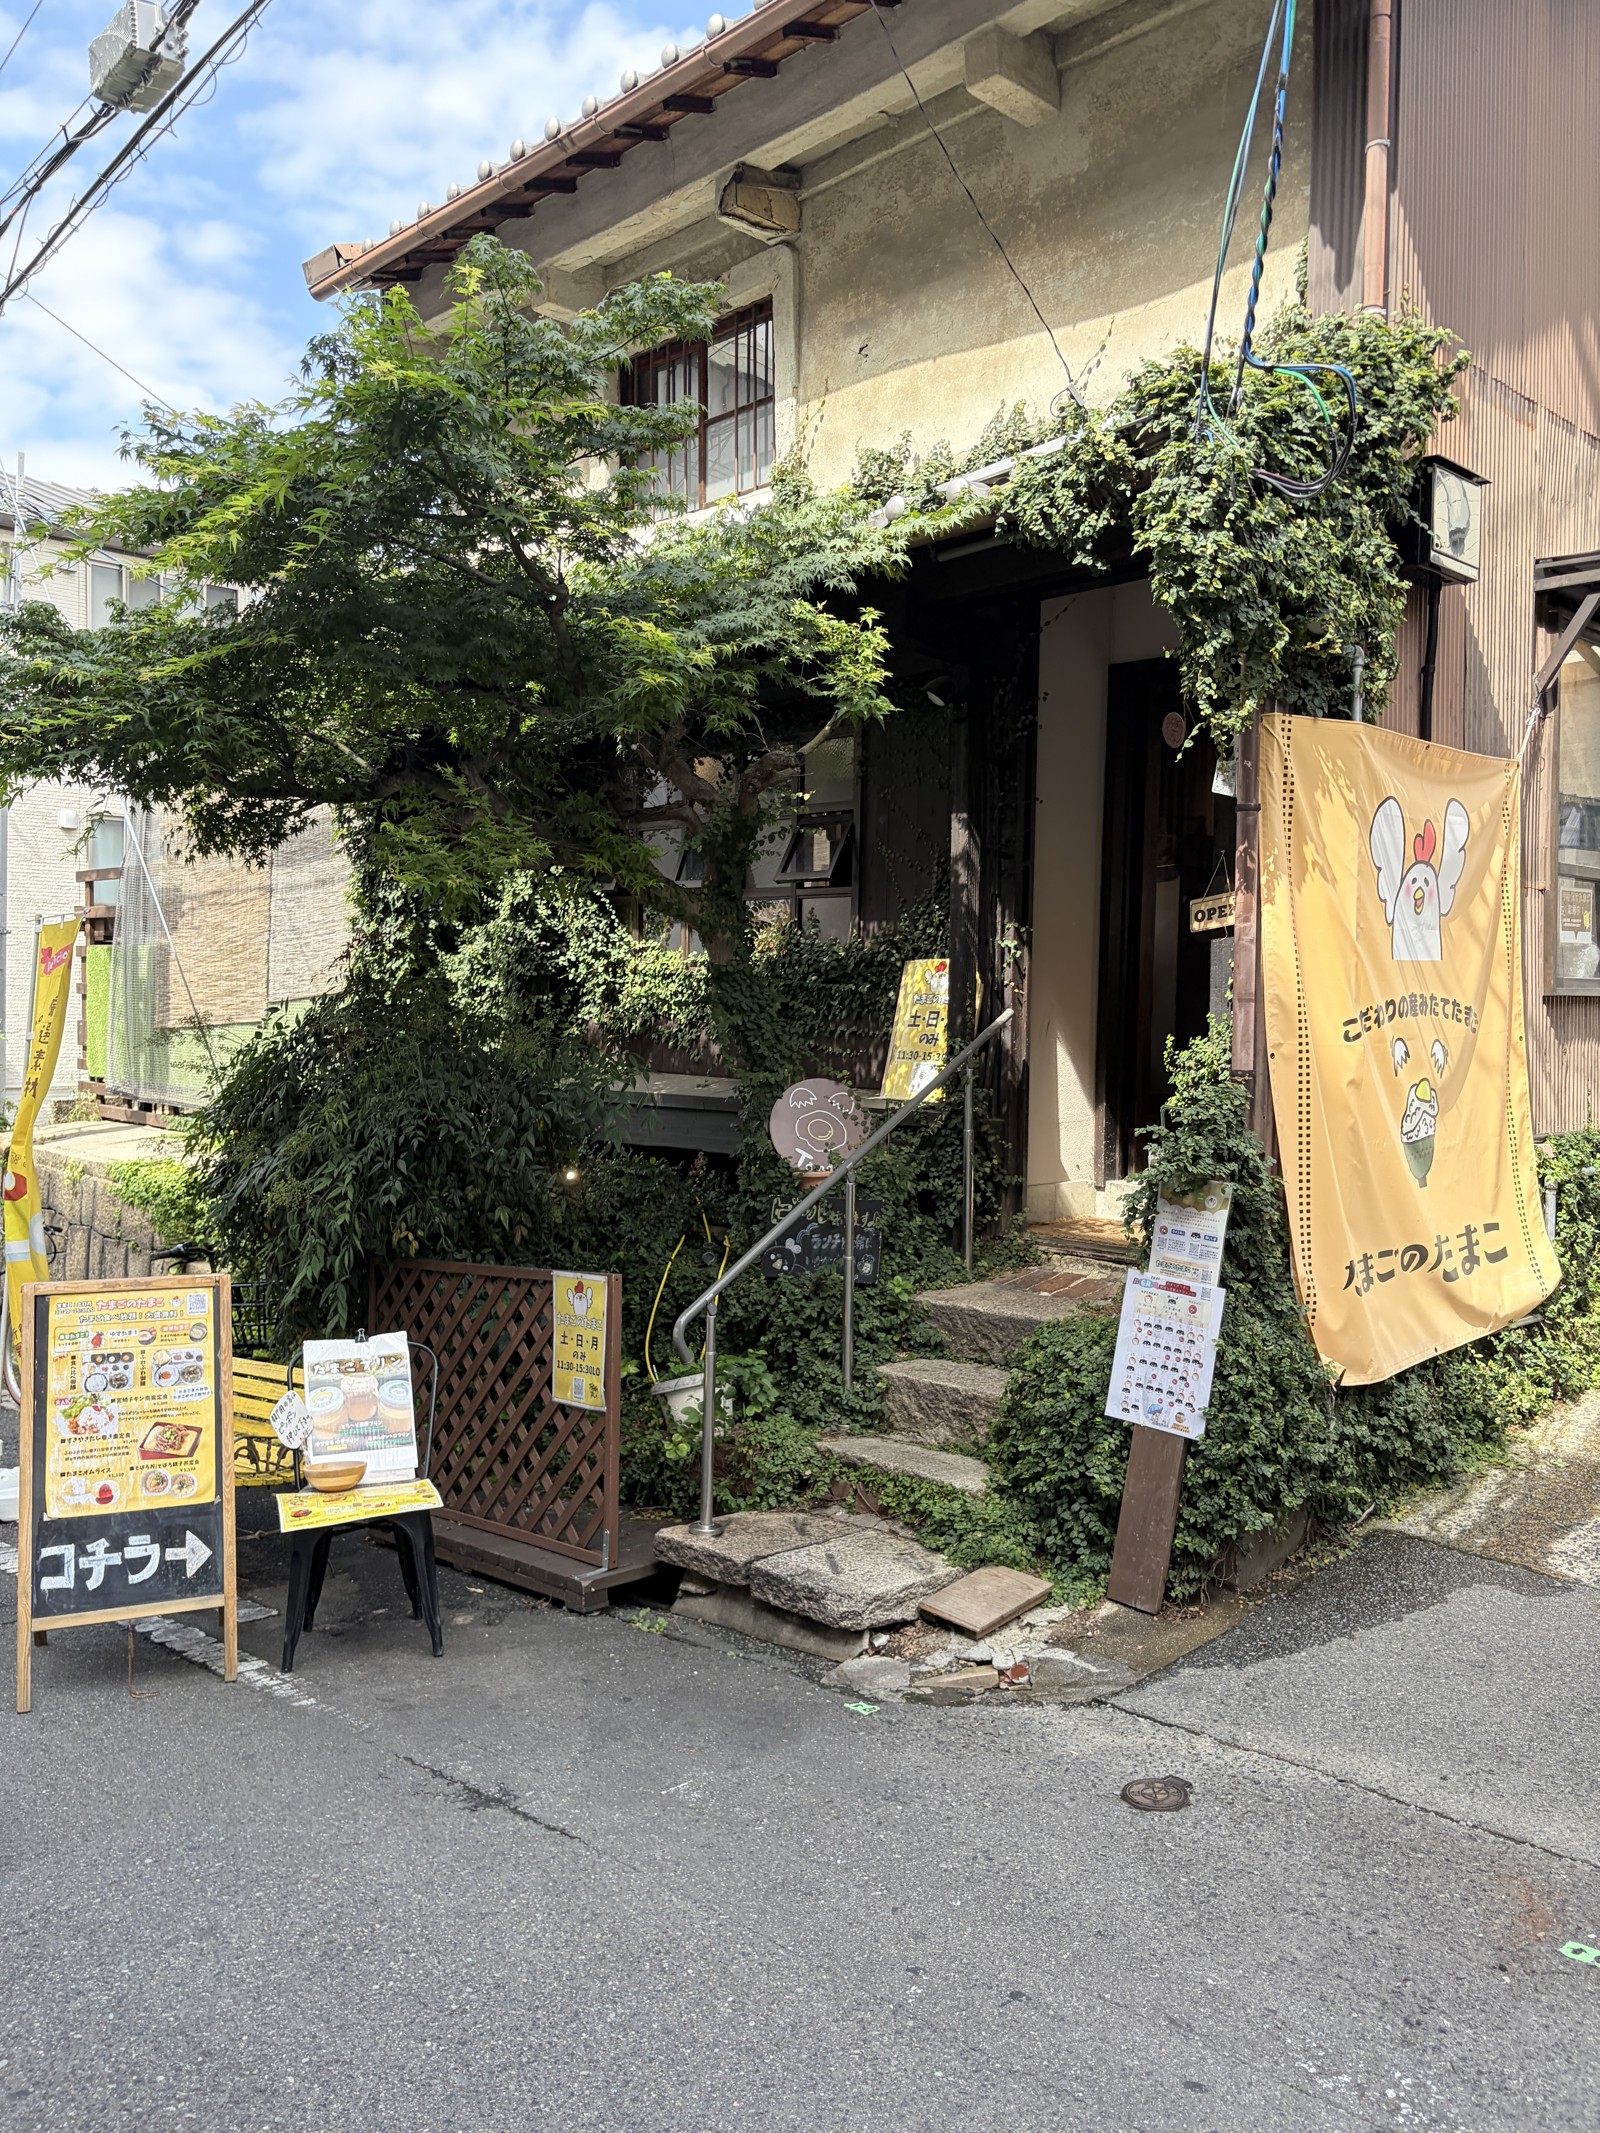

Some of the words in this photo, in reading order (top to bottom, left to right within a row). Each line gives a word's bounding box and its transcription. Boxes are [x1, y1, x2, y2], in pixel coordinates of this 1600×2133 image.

[919, 1033, 939, 1047] のみ
[560, 1331, 599, 1351] 土・日・月
[572, 1350, 586, 1362] のみ
[40, 1534, 160, 1591] コチラ
